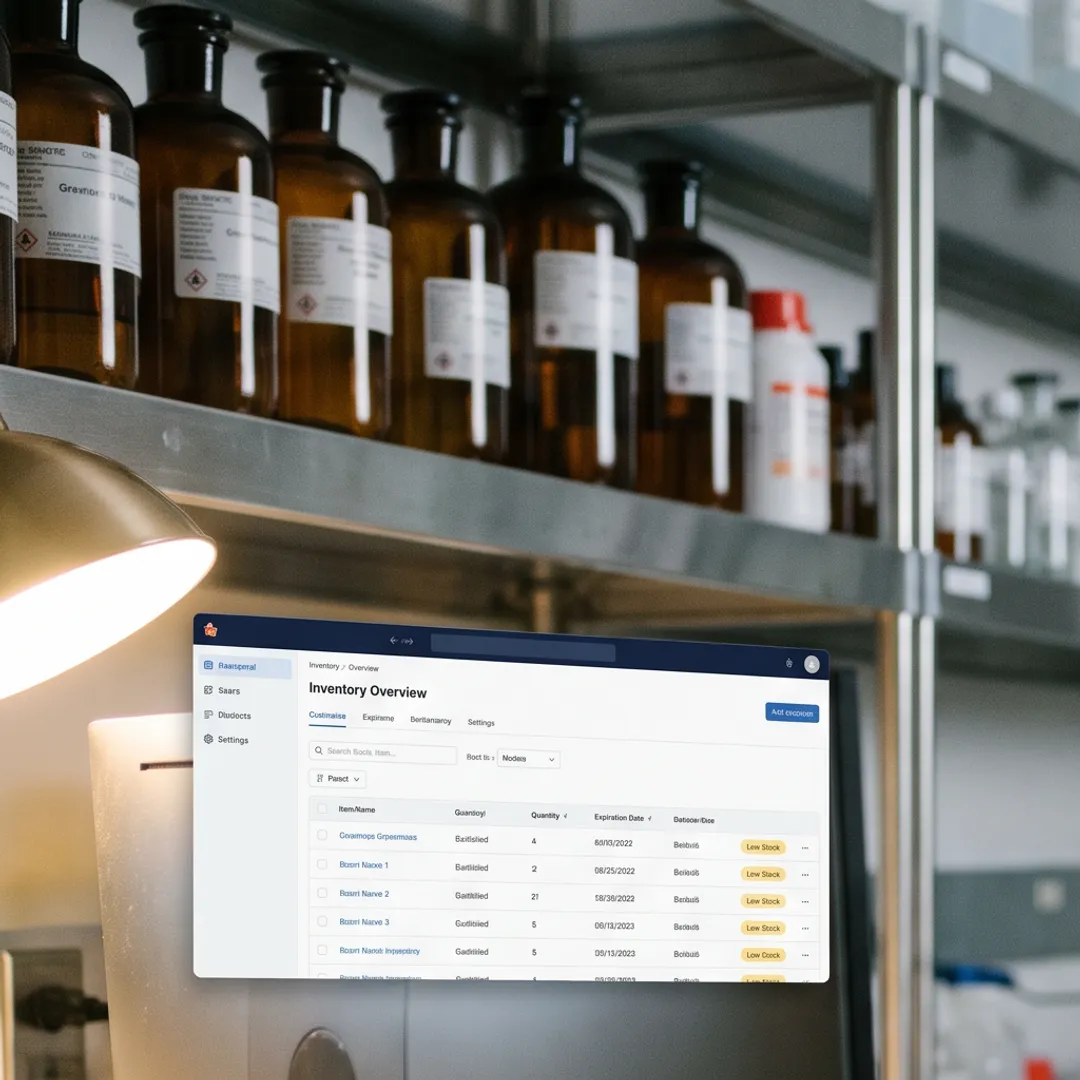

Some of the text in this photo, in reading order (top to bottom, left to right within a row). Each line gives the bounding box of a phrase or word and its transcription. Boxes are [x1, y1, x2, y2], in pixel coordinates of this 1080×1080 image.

[309, 662, 340, 671] Inventory
[310, 682, 427, 698] Inventory Overview
[468, 719, 495, 727] Settings
[218, 736, 248, 745] Settings
[531, 812, 560, 820] Quantity
[628, 814, 645, 822] Date
